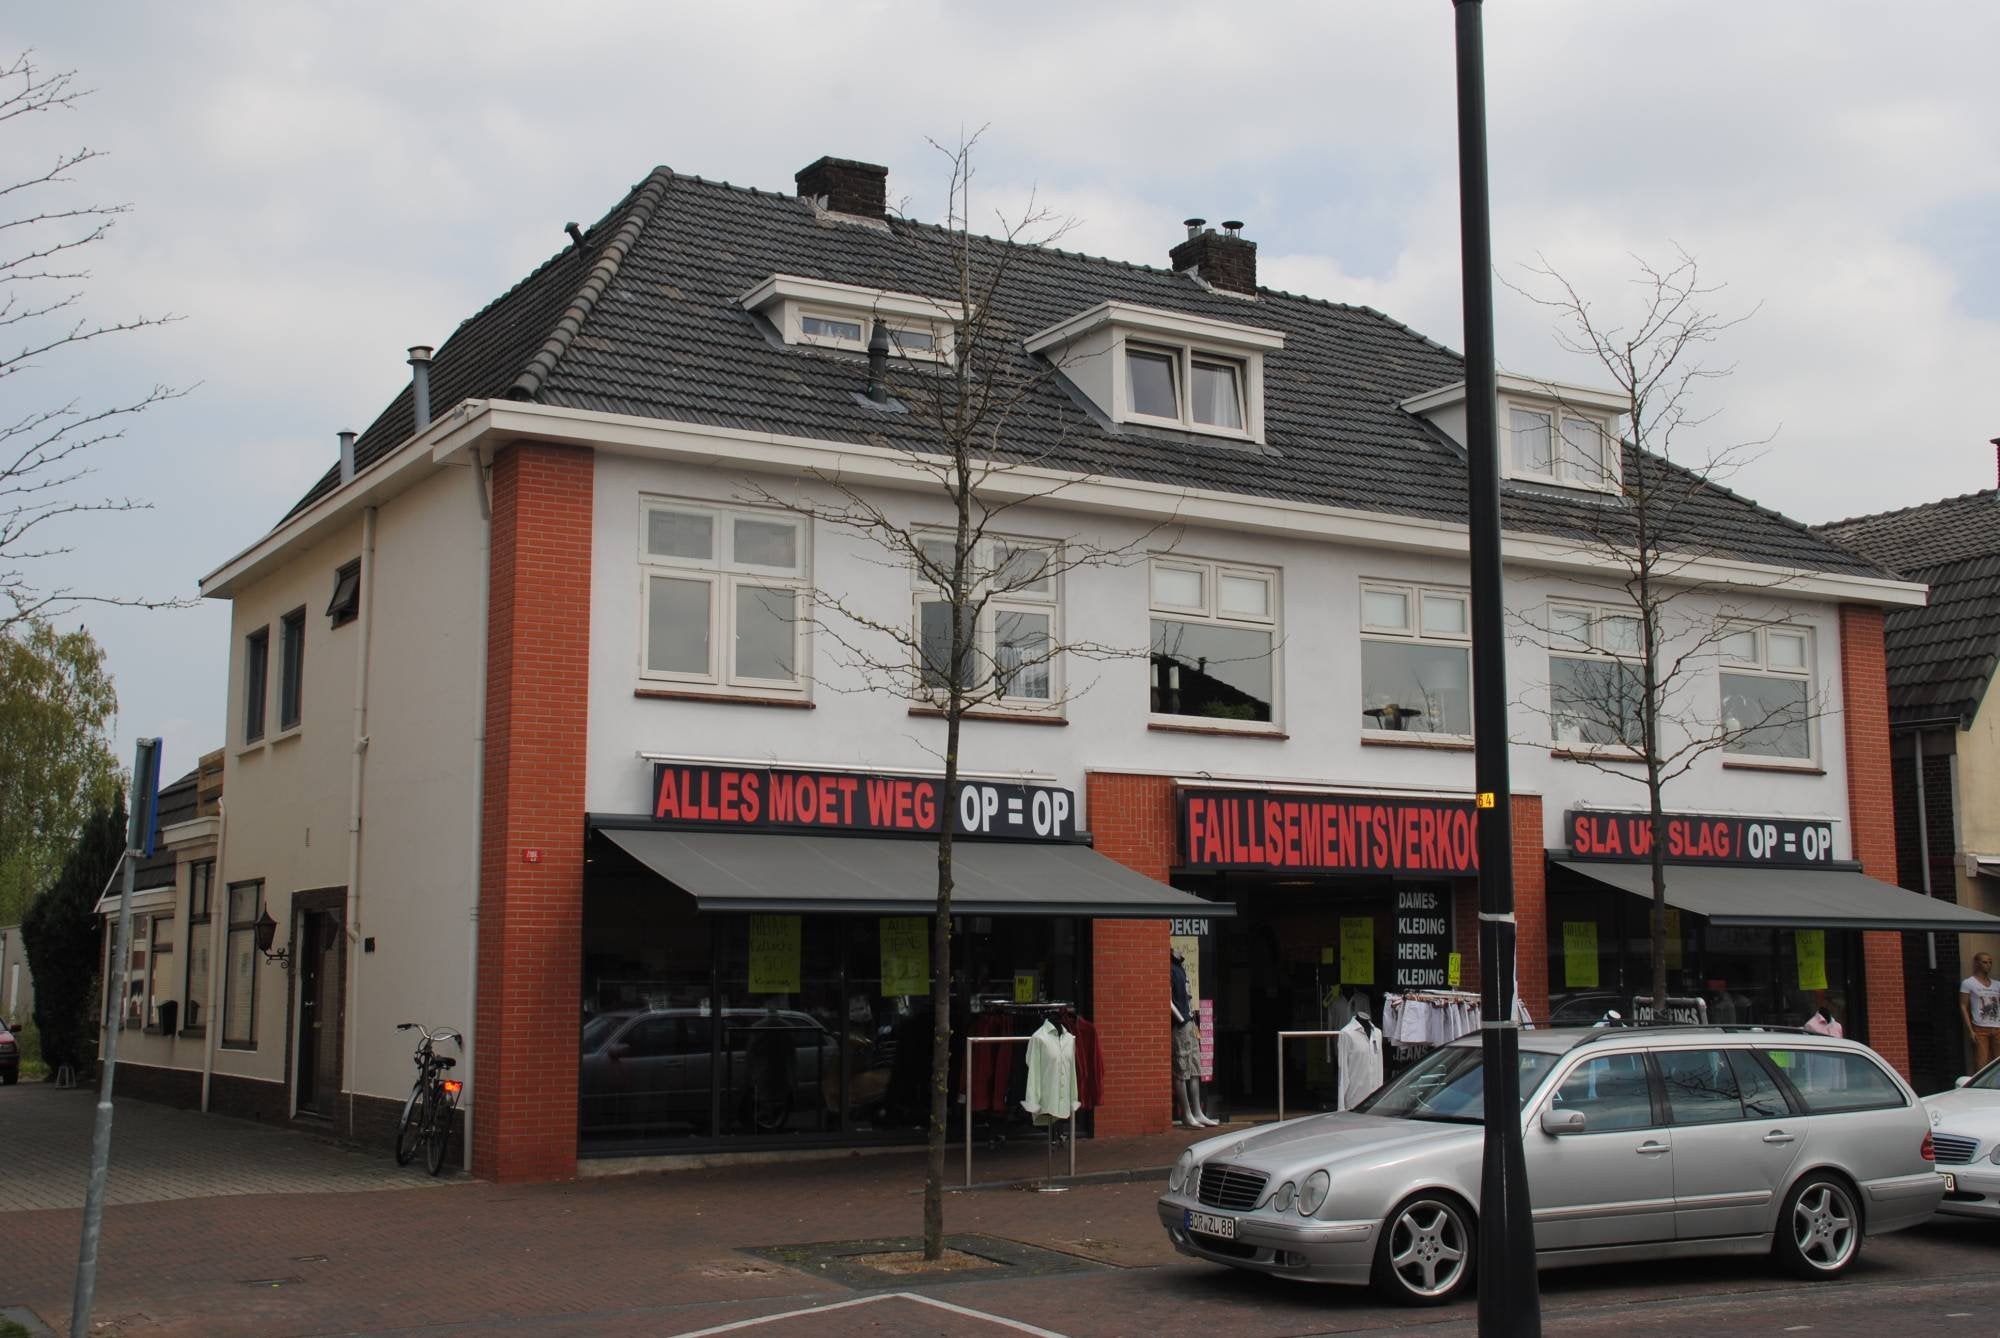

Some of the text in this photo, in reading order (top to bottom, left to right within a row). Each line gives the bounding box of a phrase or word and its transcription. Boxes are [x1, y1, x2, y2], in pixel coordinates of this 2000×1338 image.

[656, 768, 1069, 836] ALLES MOET WEG OP = OP
[1575, 816, 1622, 854] SLA
[1668, 820, 1730, 858] SLAG
[1748, 824, 1777, 858] OP
[1802, 826, 1831, 861] OP
[1398, 918, 1446, 934] KLEDING
[1397, 969, 1445, 985] KLEDING
[1221, 1219, 1233, 1236] 88
